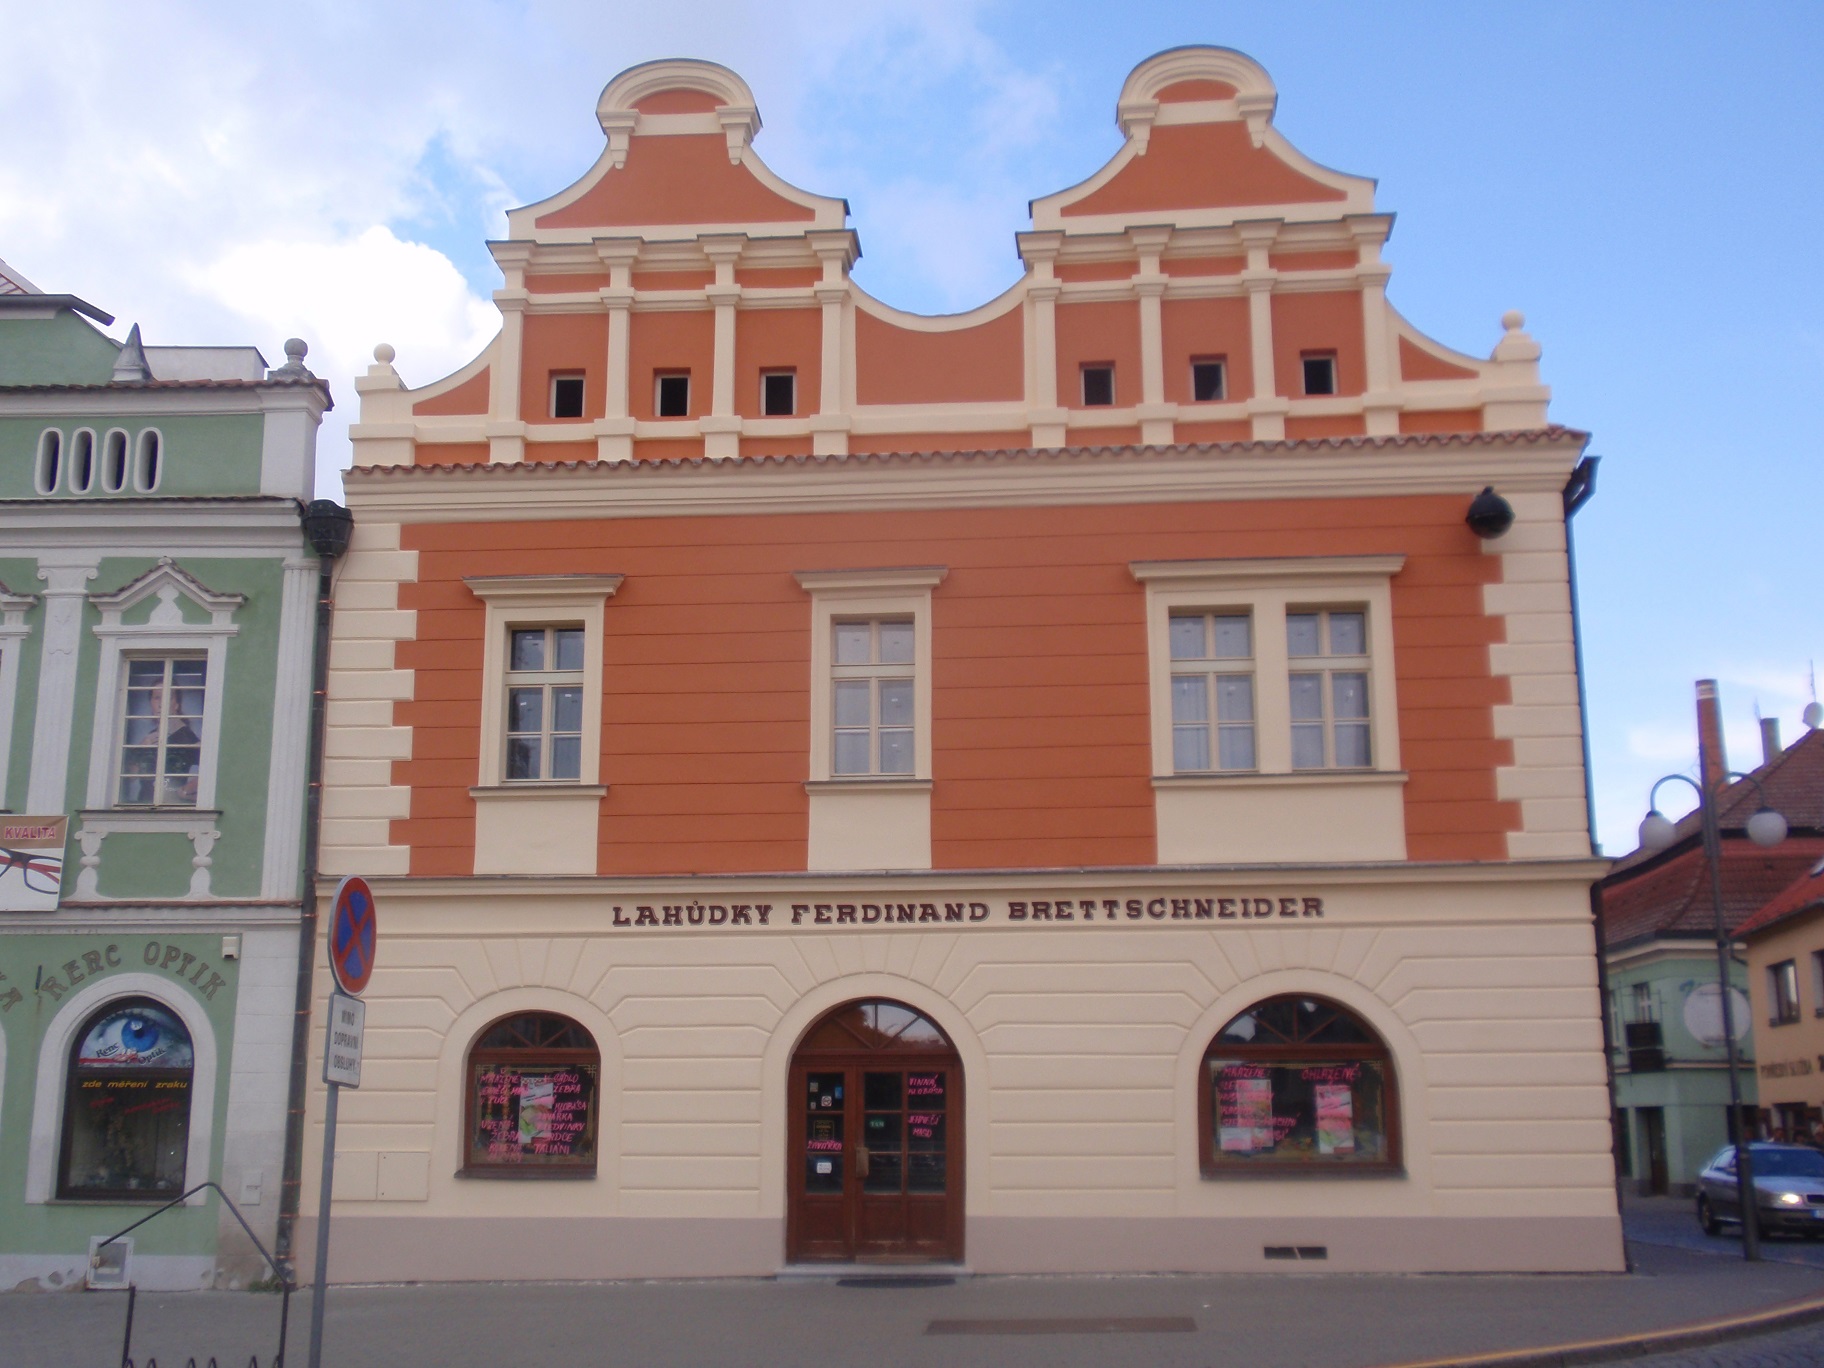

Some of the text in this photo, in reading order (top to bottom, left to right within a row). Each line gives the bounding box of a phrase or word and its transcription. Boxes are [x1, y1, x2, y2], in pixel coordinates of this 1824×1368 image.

[4, 826, 56, 839] KVALITA
[612, 898, 1325, 926] LAHŮDKY FERDINAND BRETTSCHNEIDER
[143, 941, 226, 1001] OPTIK
[95, 1042, 120, 1058] Renc
[138, 1047, 167, 1065] Optik
[82, 1080, 102, 1088] zde
[155, 1080, 188, 1089] zraku
